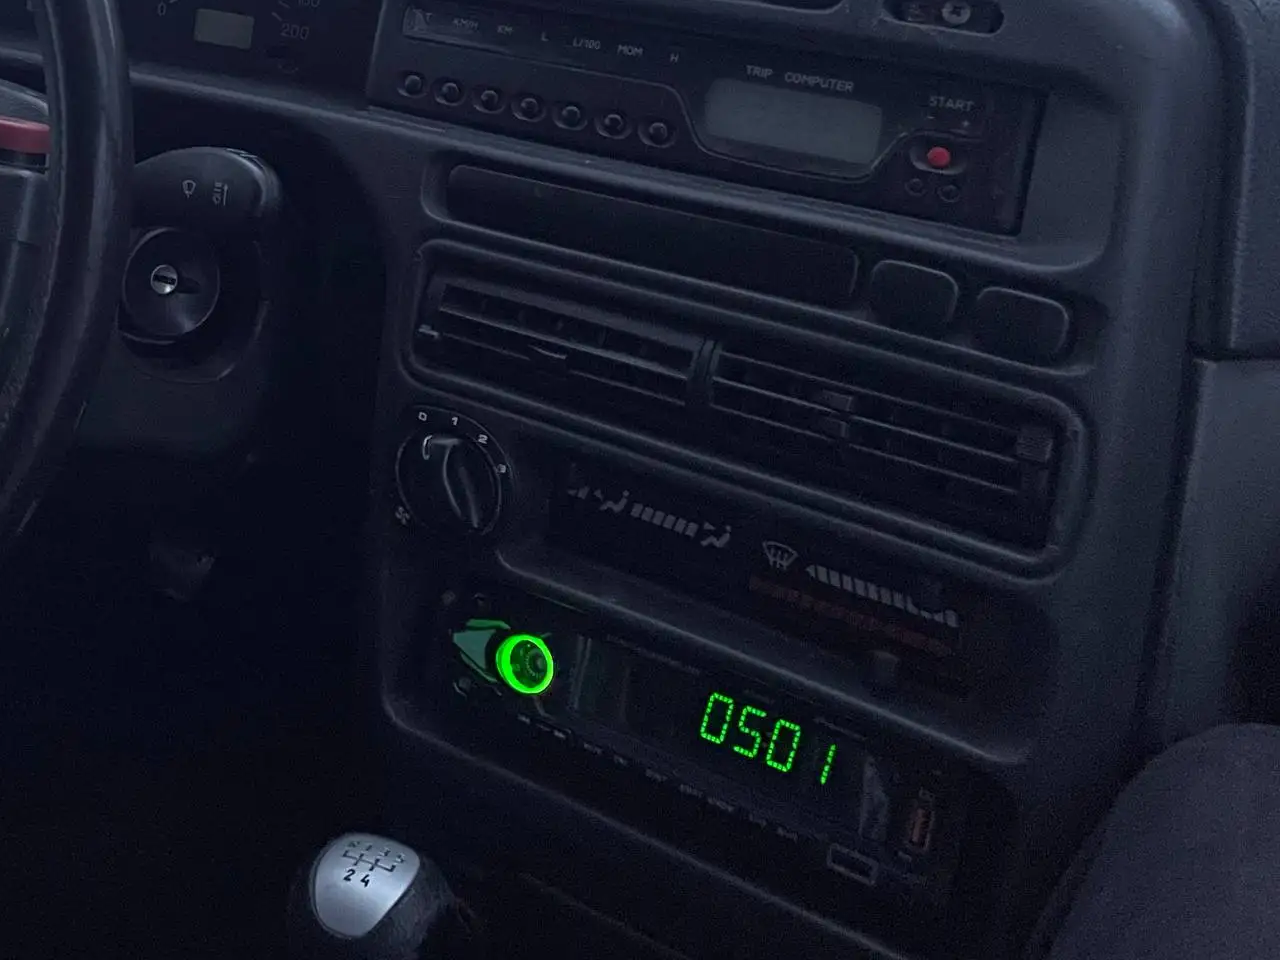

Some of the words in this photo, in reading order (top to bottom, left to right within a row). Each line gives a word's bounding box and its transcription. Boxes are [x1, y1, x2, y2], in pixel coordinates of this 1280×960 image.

[157, 2, 166, 16] 0
[280, 23, 310, 40] 200
[572, 36, 601, 50] L/100
[617, 43, 644, 58] MOM
[670, 52, 680, 64] H
[745, 64, 774, 80] TRIP
[784, 71, 855, 93] COMPUTER
[929, 94, 975, 113] START
[343, 868, 356, 882] 2
[360, 874, 370, 888] 4
